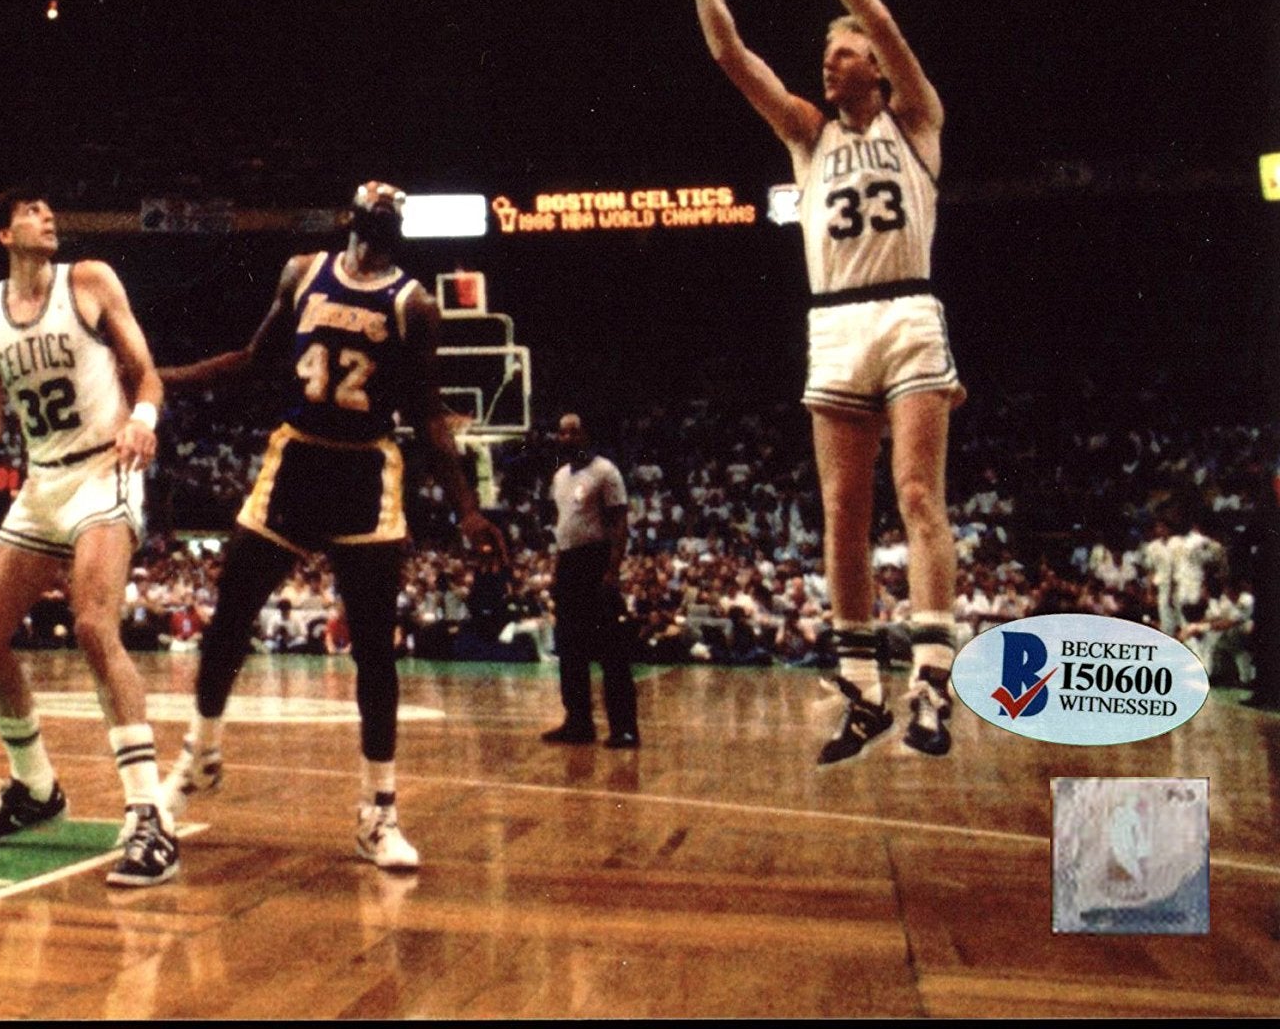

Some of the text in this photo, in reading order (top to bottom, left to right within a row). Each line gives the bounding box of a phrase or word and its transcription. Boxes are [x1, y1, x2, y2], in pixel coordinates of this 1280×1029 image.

[823, 138, 901, 184] CELTICS
[536, 186, 734, 213] BOSTON CELTICS
[561, 210, 595, 231] NBA
[598, 209, 655, 229] WORLD
[661, 204, 756, 226] CHAMPIONS
[825, 180, 906, 241] 33
[296, 342, 372, 412] 42
[17, 376, 82, 437] 32
